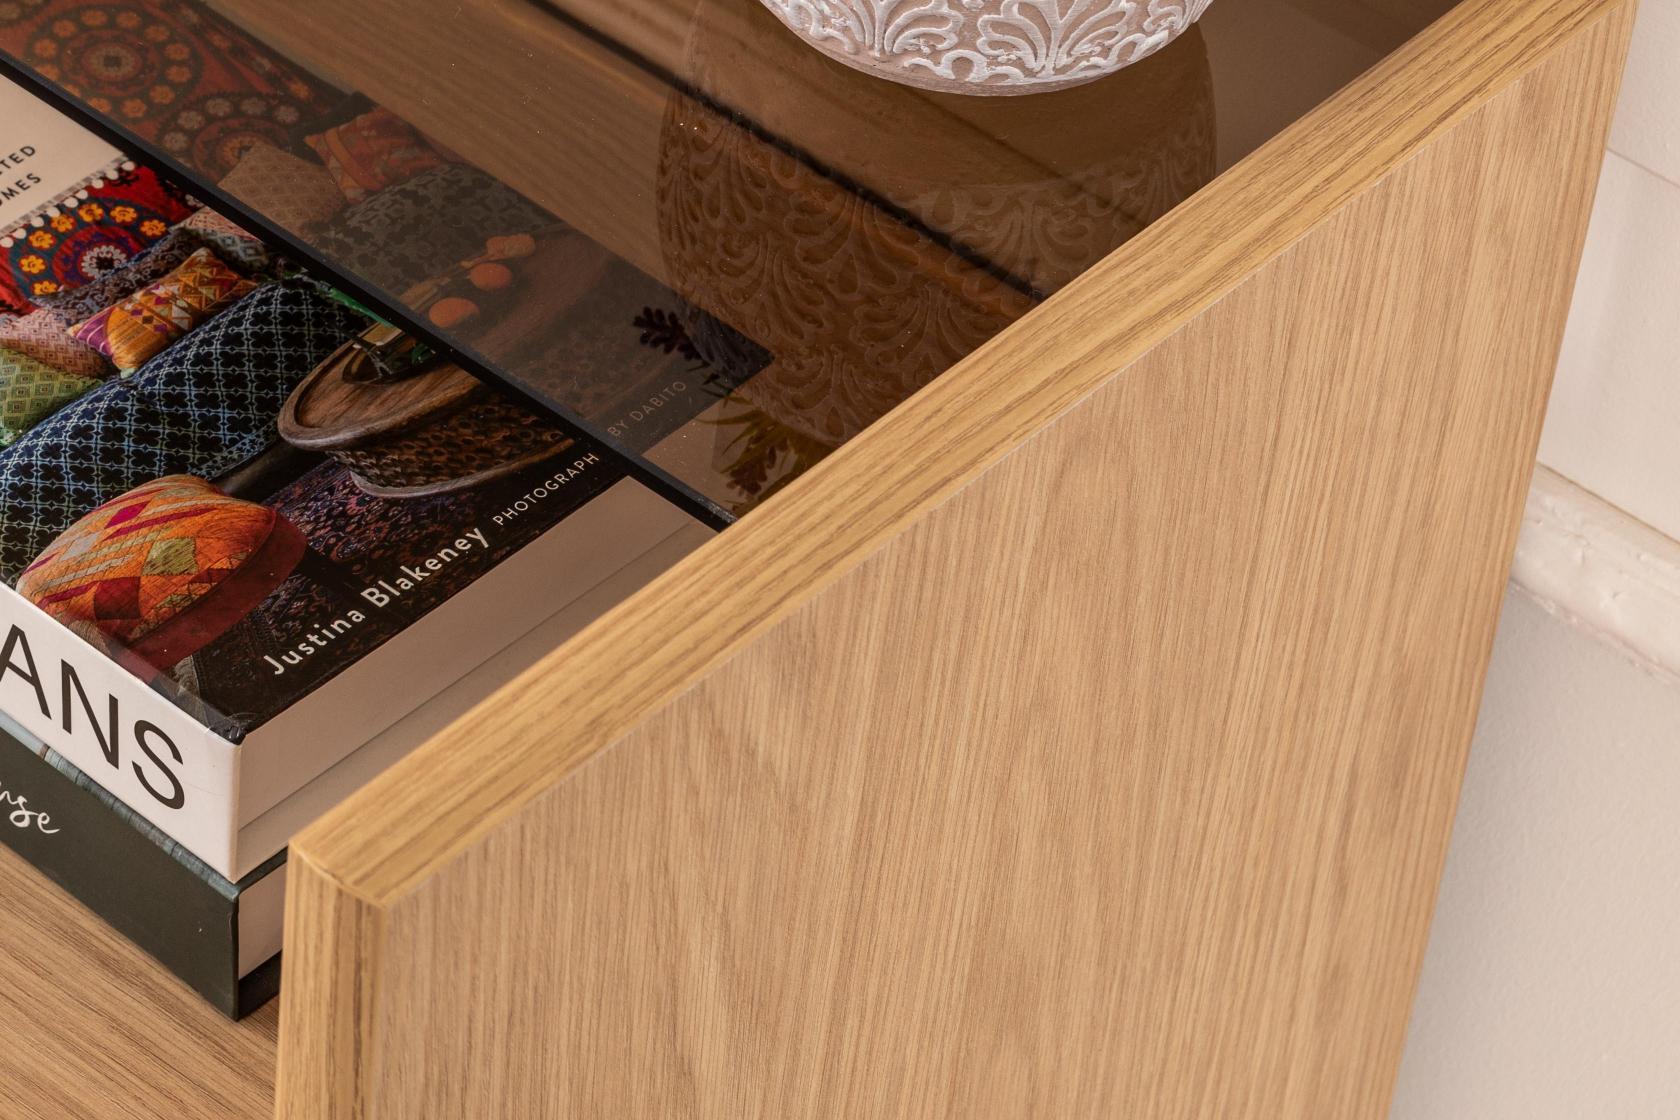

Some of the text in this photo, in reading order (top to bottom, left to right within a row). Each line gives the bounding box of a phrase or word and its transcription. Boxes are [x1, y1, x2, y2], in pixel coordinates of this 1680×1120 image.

[263, 381, 687, 676] Justina Blakeney PHOTOGRAPH BY DABITO
